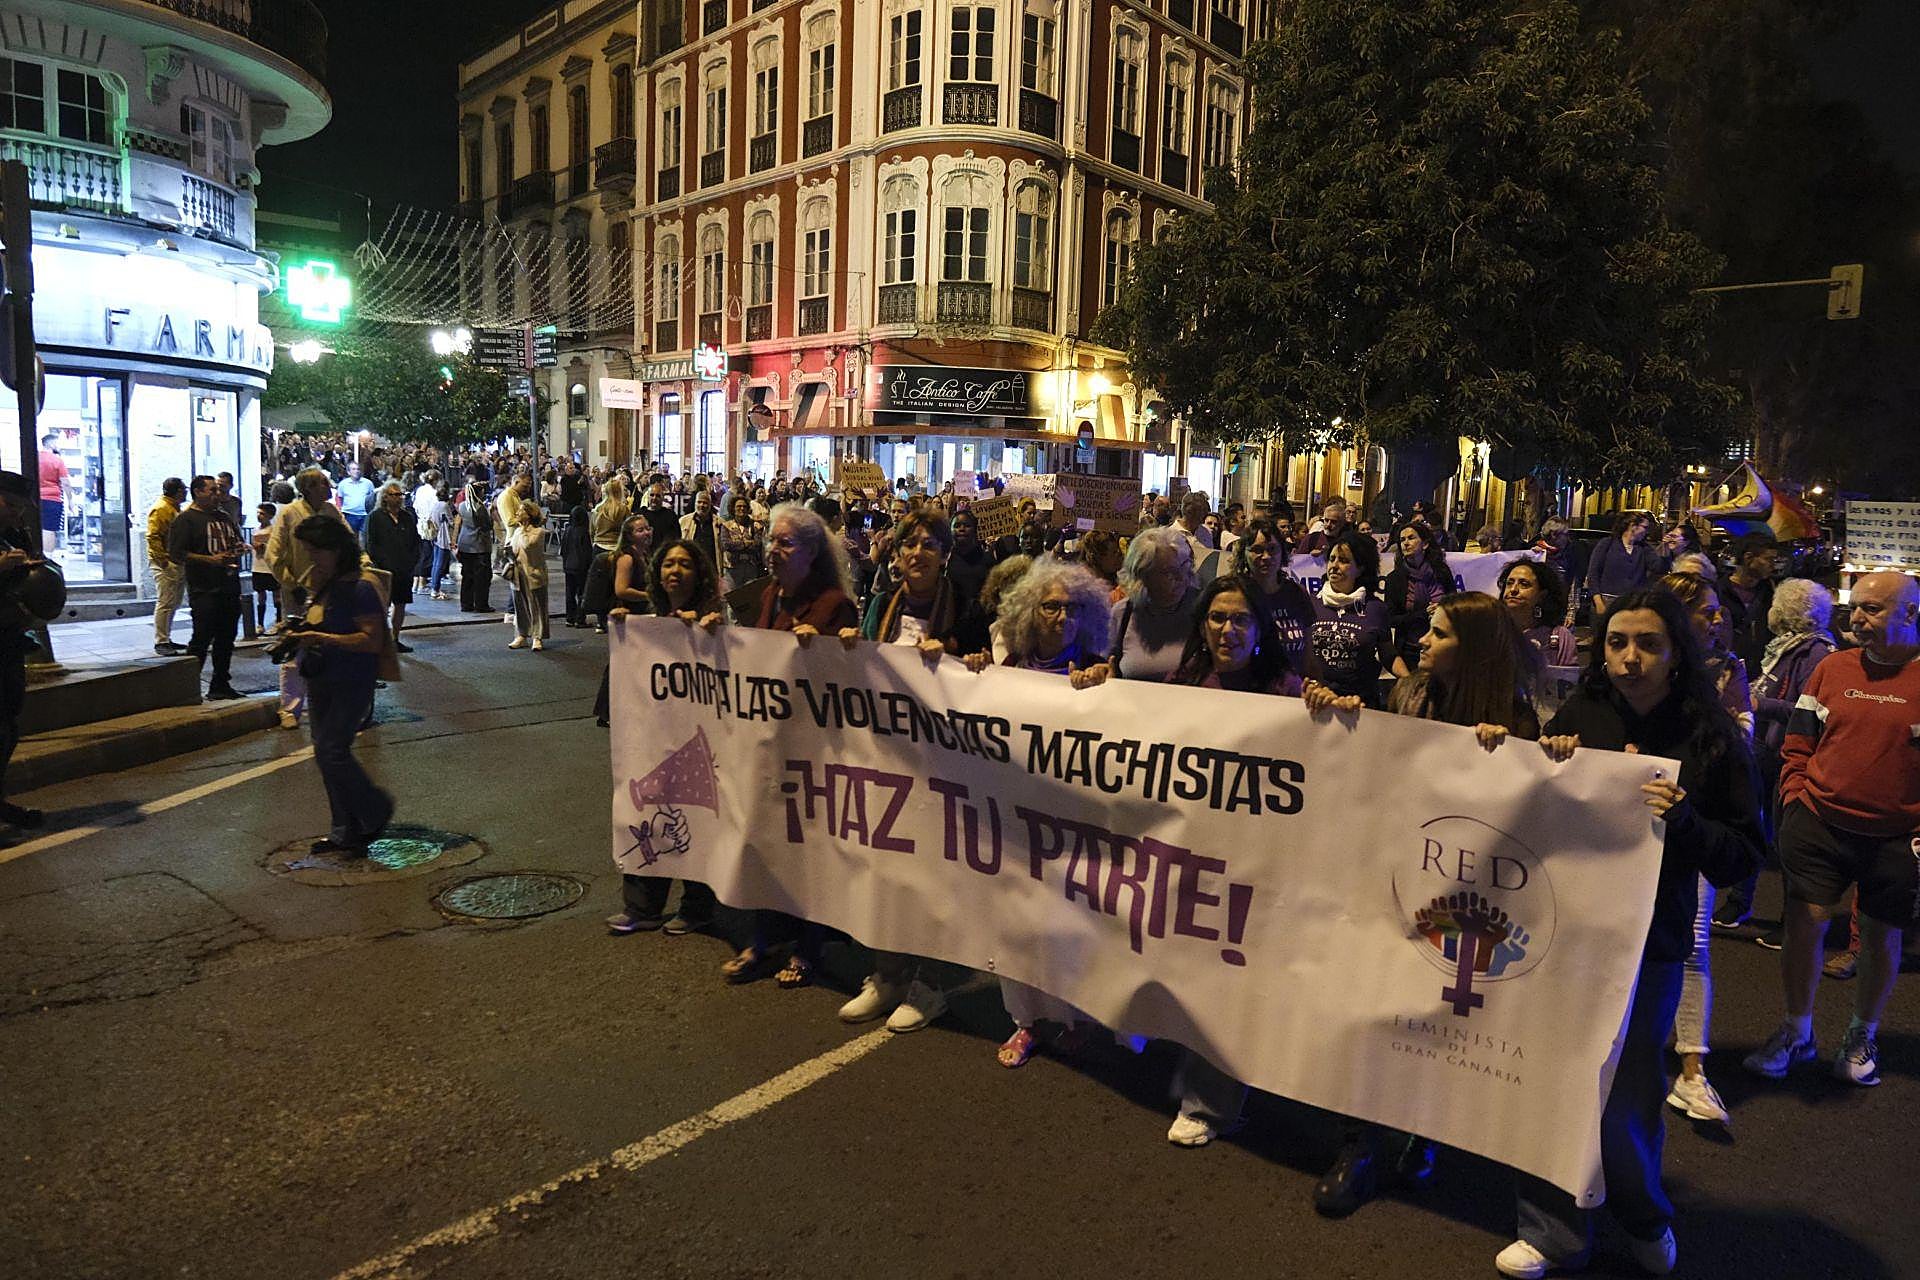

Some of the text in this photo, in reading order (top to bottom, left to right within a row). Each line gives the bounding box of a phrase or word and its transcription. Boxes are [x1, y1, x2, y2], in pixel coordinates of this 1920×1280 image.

[647, 361, 694, 380] FARMAC
[908, 378, 960, 400] Antico
[651, 662, 1305, 815] CONTRA LAS VIOLENCIAS MACHISTAS
[781, 759, 1254, 967] ¡HAZ TU PARTE!
[1421, 837, 1529, 891] RED
[1394, 1014, 1524, 1059] FEMINISTA
[1448, 1042, 1468, 1055] DE
[1391, 1041, 1523, 1086] GRAN CANARIA
